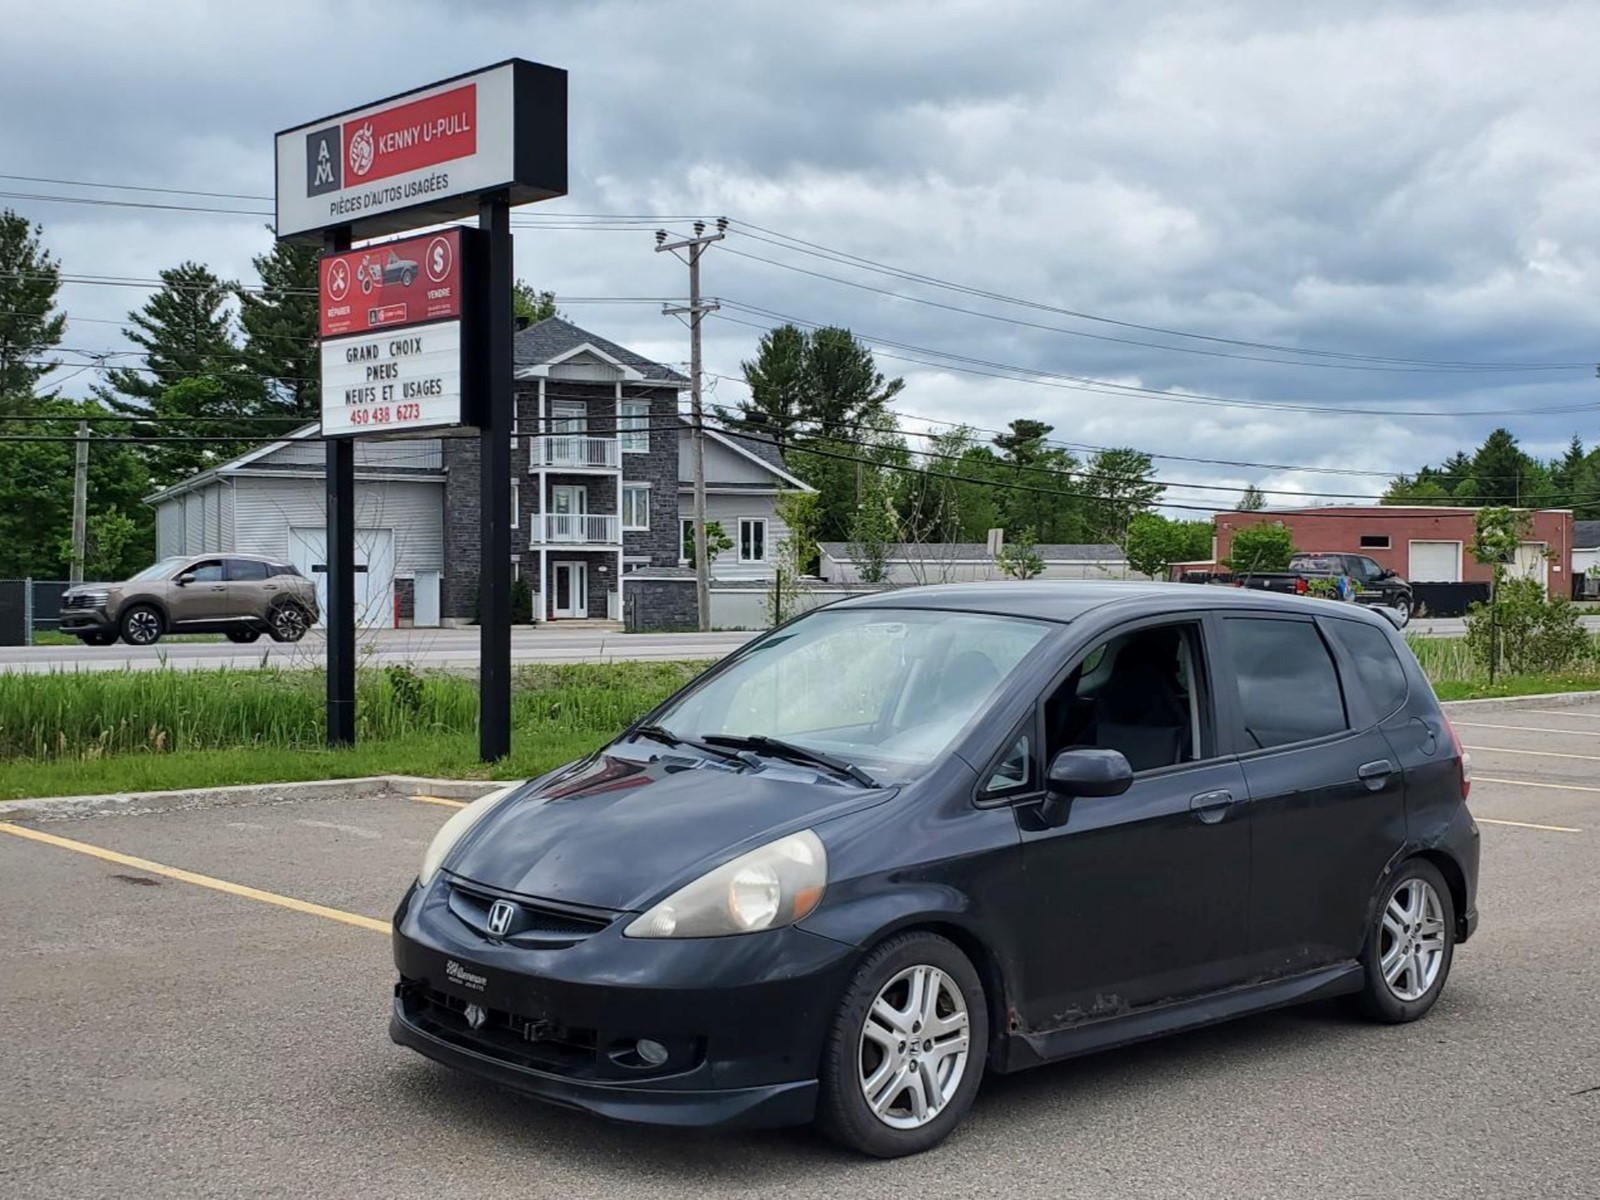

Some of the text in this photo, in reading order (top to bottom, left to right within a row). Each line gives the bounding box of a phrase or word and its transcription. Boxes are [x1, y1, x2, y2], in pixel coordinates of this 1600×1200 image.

[378, 112, 470, 155] KENNY U-PULL
[330, 173, 449, 216] PIÈCES D'AUTOS USAGÉES
[346, 338, 422, 363] GRAND CHOIX
[366, 363, 398, 381] PNEUS
[345, 379, 442, 405] NEUFS ET USAGES
[350, 404, 420, 425] 450 438 6273
